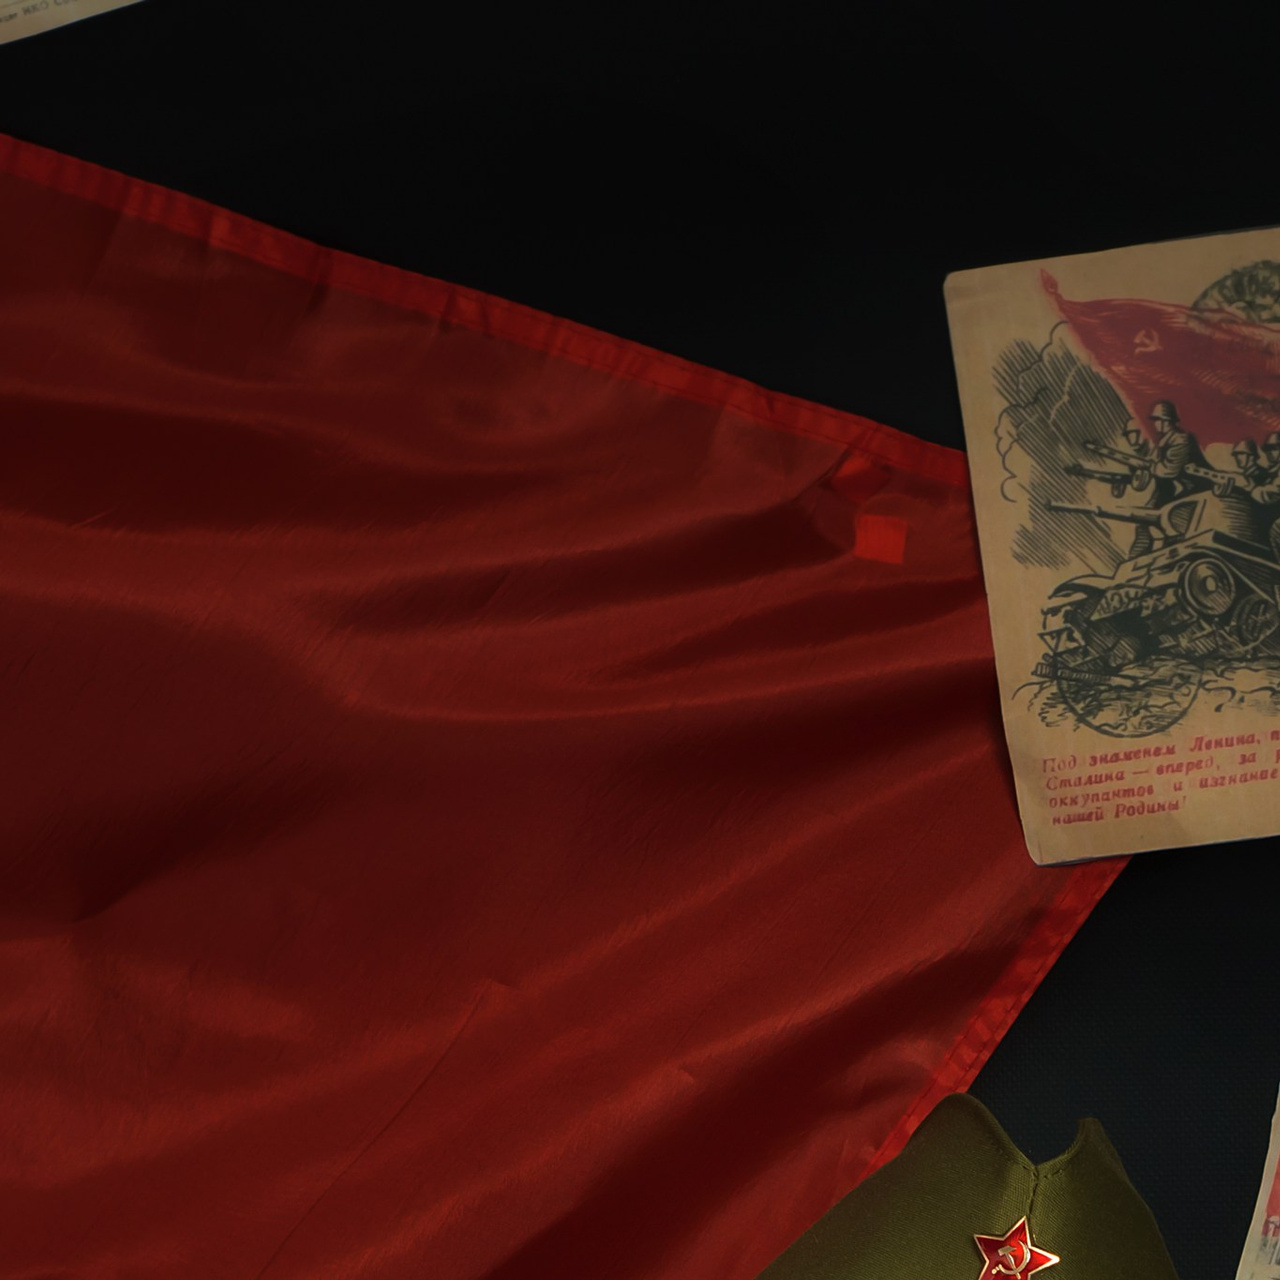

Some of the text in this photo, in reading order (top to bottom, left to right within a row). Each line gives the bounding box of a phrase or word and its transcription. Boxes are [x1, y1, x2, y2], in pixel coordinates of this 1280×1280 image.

[1041, 754, 1077, 774] Под
[1088, 744, 1176, 766] знаменем
[1189, 733, 1261, 753] Ленина,
[1045, 770, 1125, 791] Сталина
[1155, 756, 1220, 776] вперед,
[1238, 752, 1257, 765] за
[1048, 784, 1154, 809] оккупантов
[1173, 781, 1183, 792] и
[1198, 767, 1279, 789] изгнание
[1052, 795, 1187, 826] нашей Родины!
